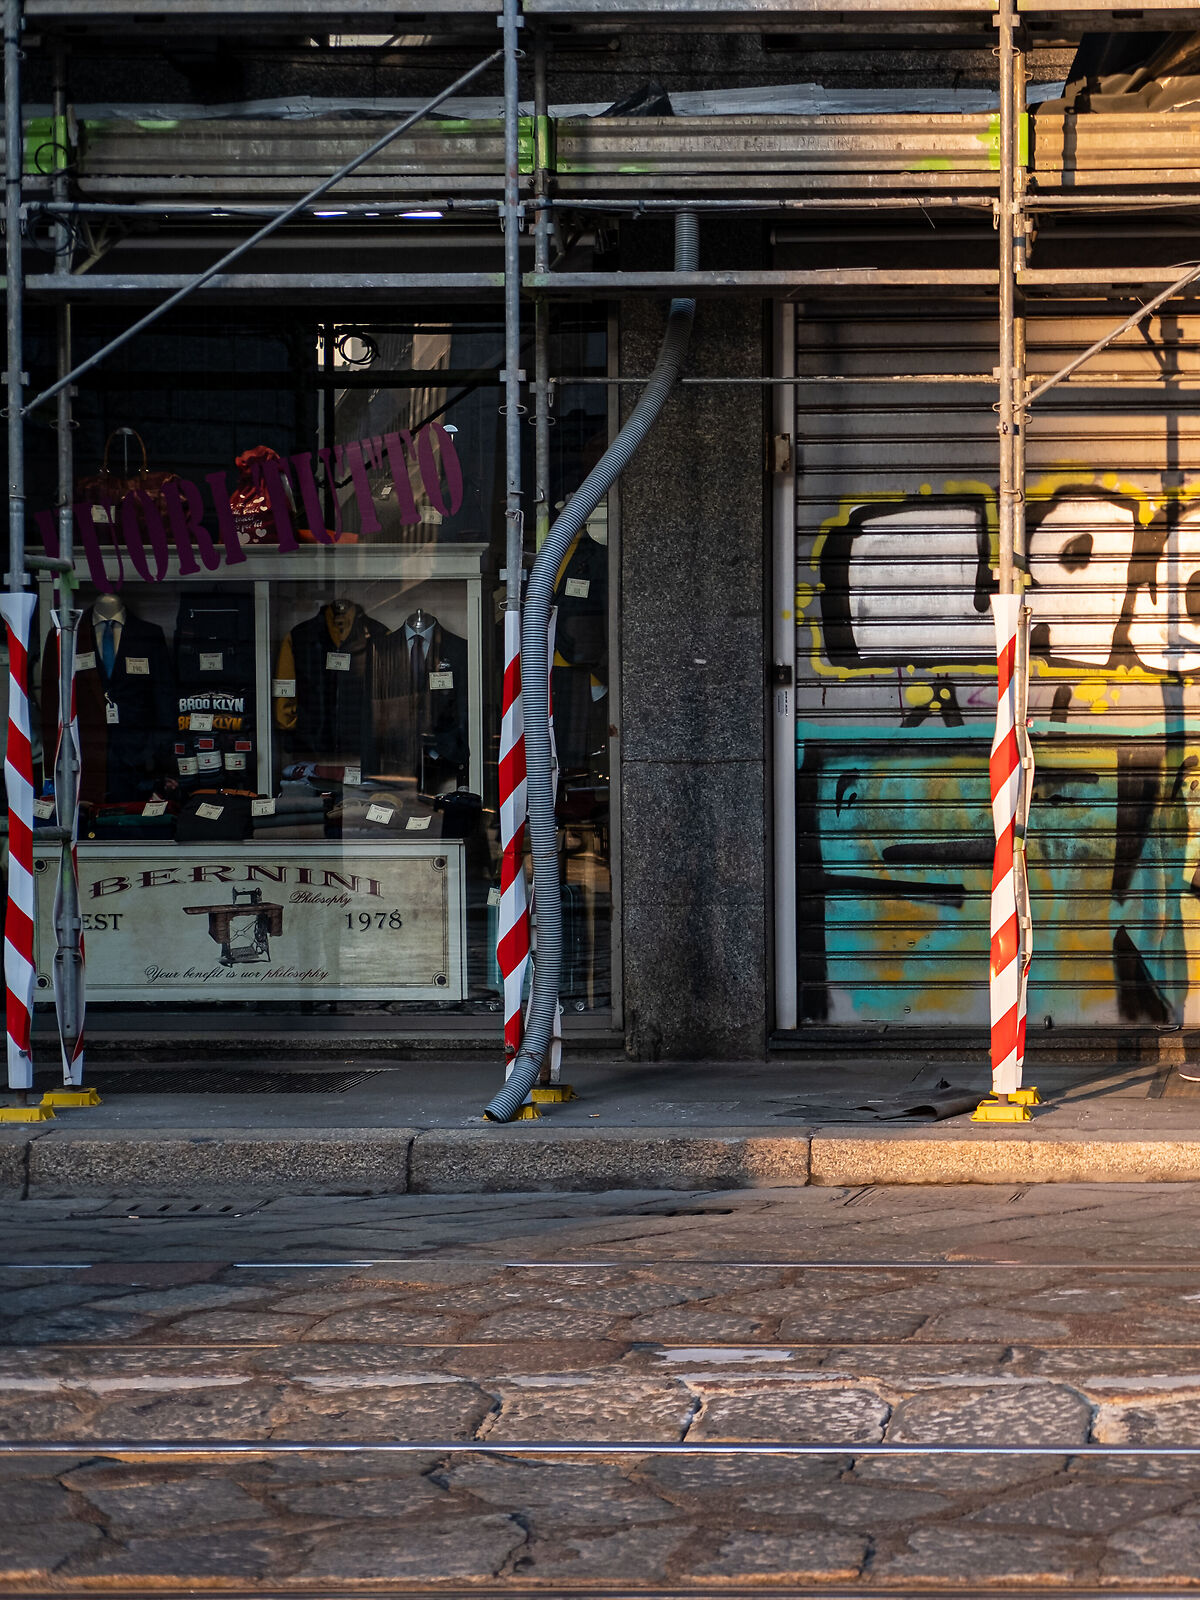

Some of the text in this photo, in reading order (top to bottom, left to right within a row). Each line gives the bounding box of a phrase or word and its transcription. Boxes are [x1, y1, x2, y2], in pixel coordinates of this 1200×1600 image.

[251, 421, 463, 553] TUTTO
[90, 864, 386, 899] BERNINI
[289, 889, 353, 908] Philosophy
[82, 913, 124, 931] EST
[345, 909, 403, 932] 1978
[145, 964, 179, 983] Your
[226, 970, 237, 979] is
[260, 965, 329, 982] philosophy
